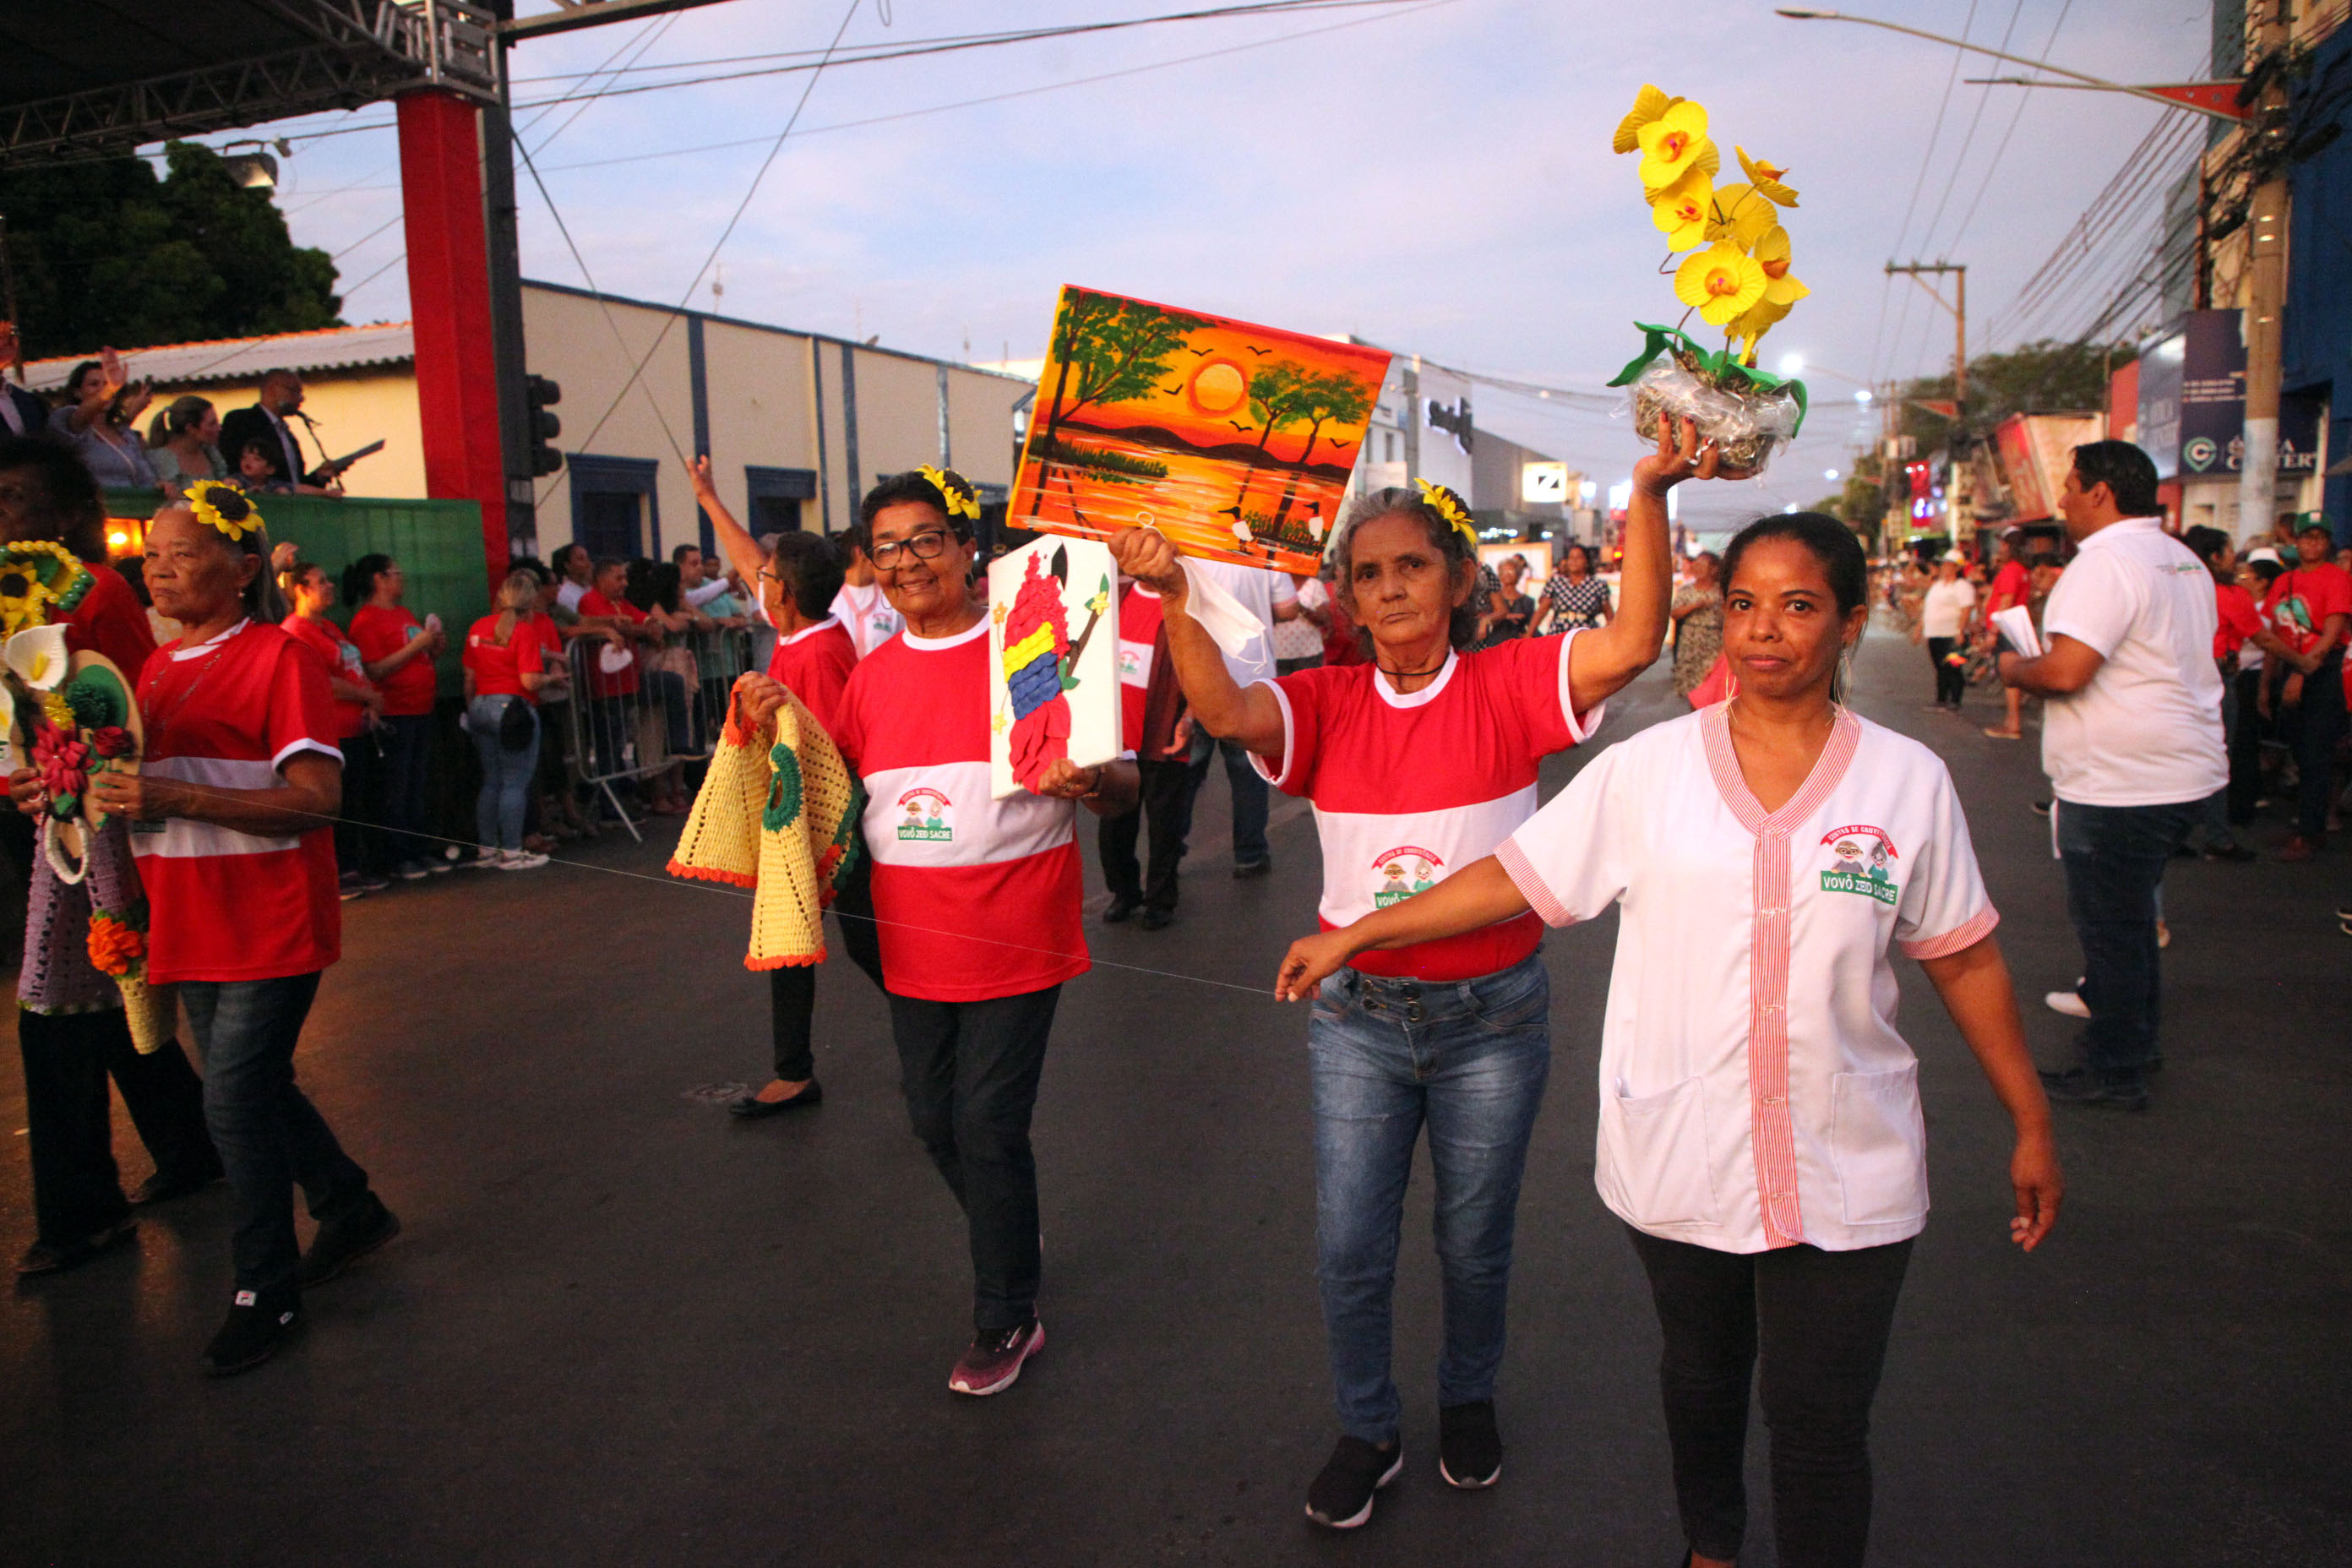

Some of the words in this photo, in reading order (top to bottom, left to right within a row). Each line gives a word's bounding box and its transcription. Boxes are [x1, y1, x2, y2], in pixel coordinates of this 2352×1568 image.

[1823, 874, 1853, 890] VOVÔ
[1855, 879, 1872, 893] ZEID
[1874, 884, 1896, 901] SACRE
